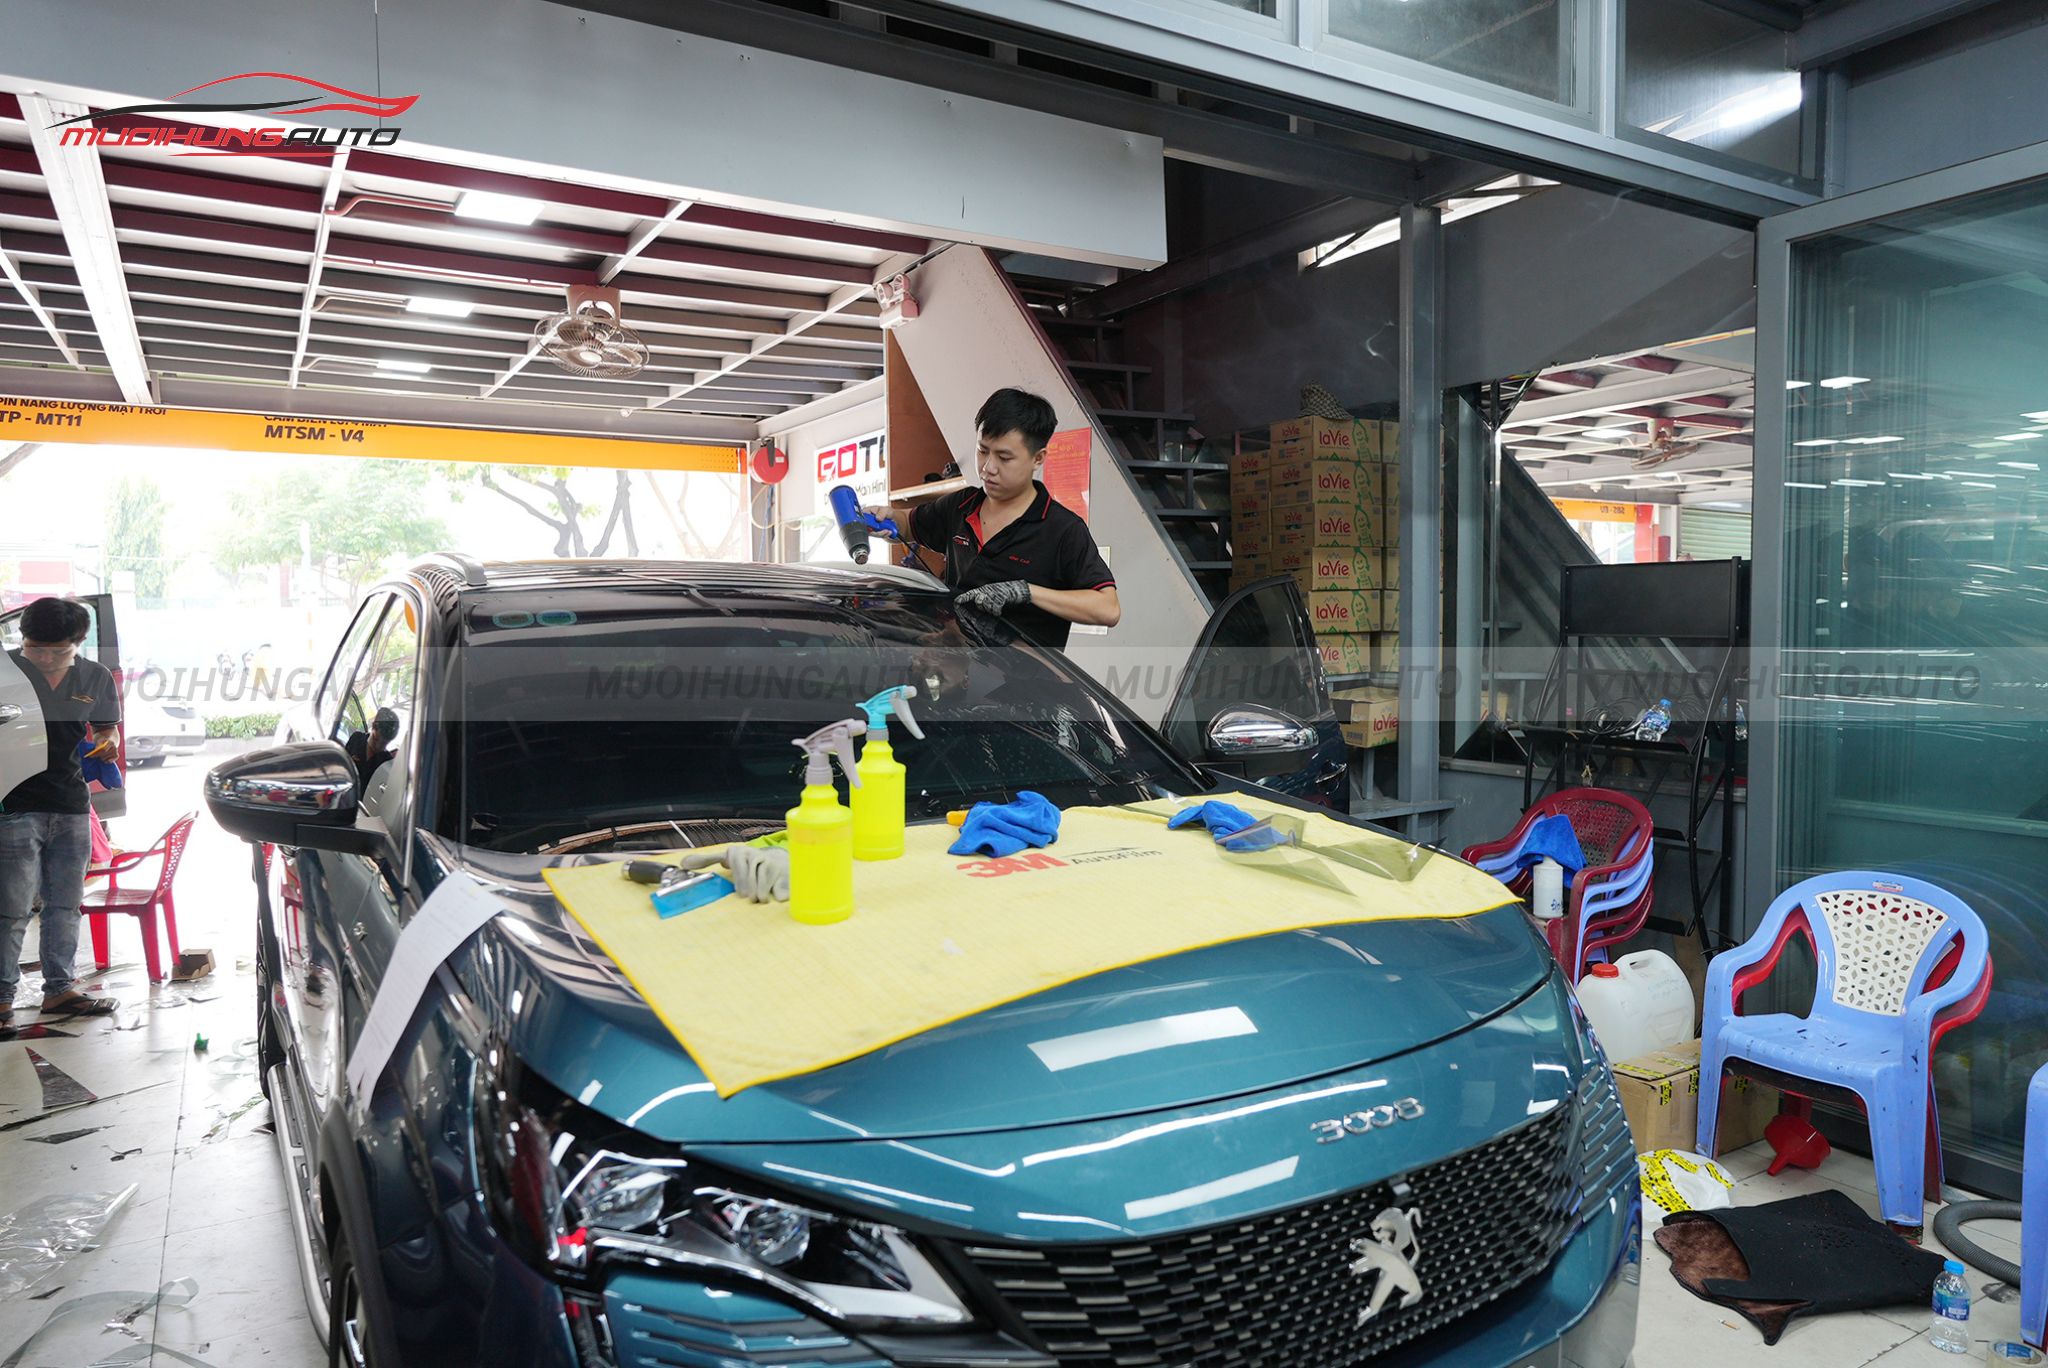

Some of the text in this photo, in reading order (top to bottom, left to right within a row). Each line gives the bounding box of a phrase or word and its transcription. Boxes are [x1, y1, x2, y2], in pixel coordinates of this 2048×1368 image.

[35, 413, 82, 427] MT11
[264, 424, 325, 440] MTSM
[340, 428, 364, 442] V4
[1319, 429, 1350, 447] laVie
[1319, 473, 1350, 489] laVie
[1319, 517, 1351, 533] laVie
[1318, 560, 1350, 576] laVie
[1316, 603, 1348, 619] laVie
[1320, 646, 1340, 661] Vie
[1373, 713, 1398, 732] laVie
[956, 853, 1070, 878] 3M
